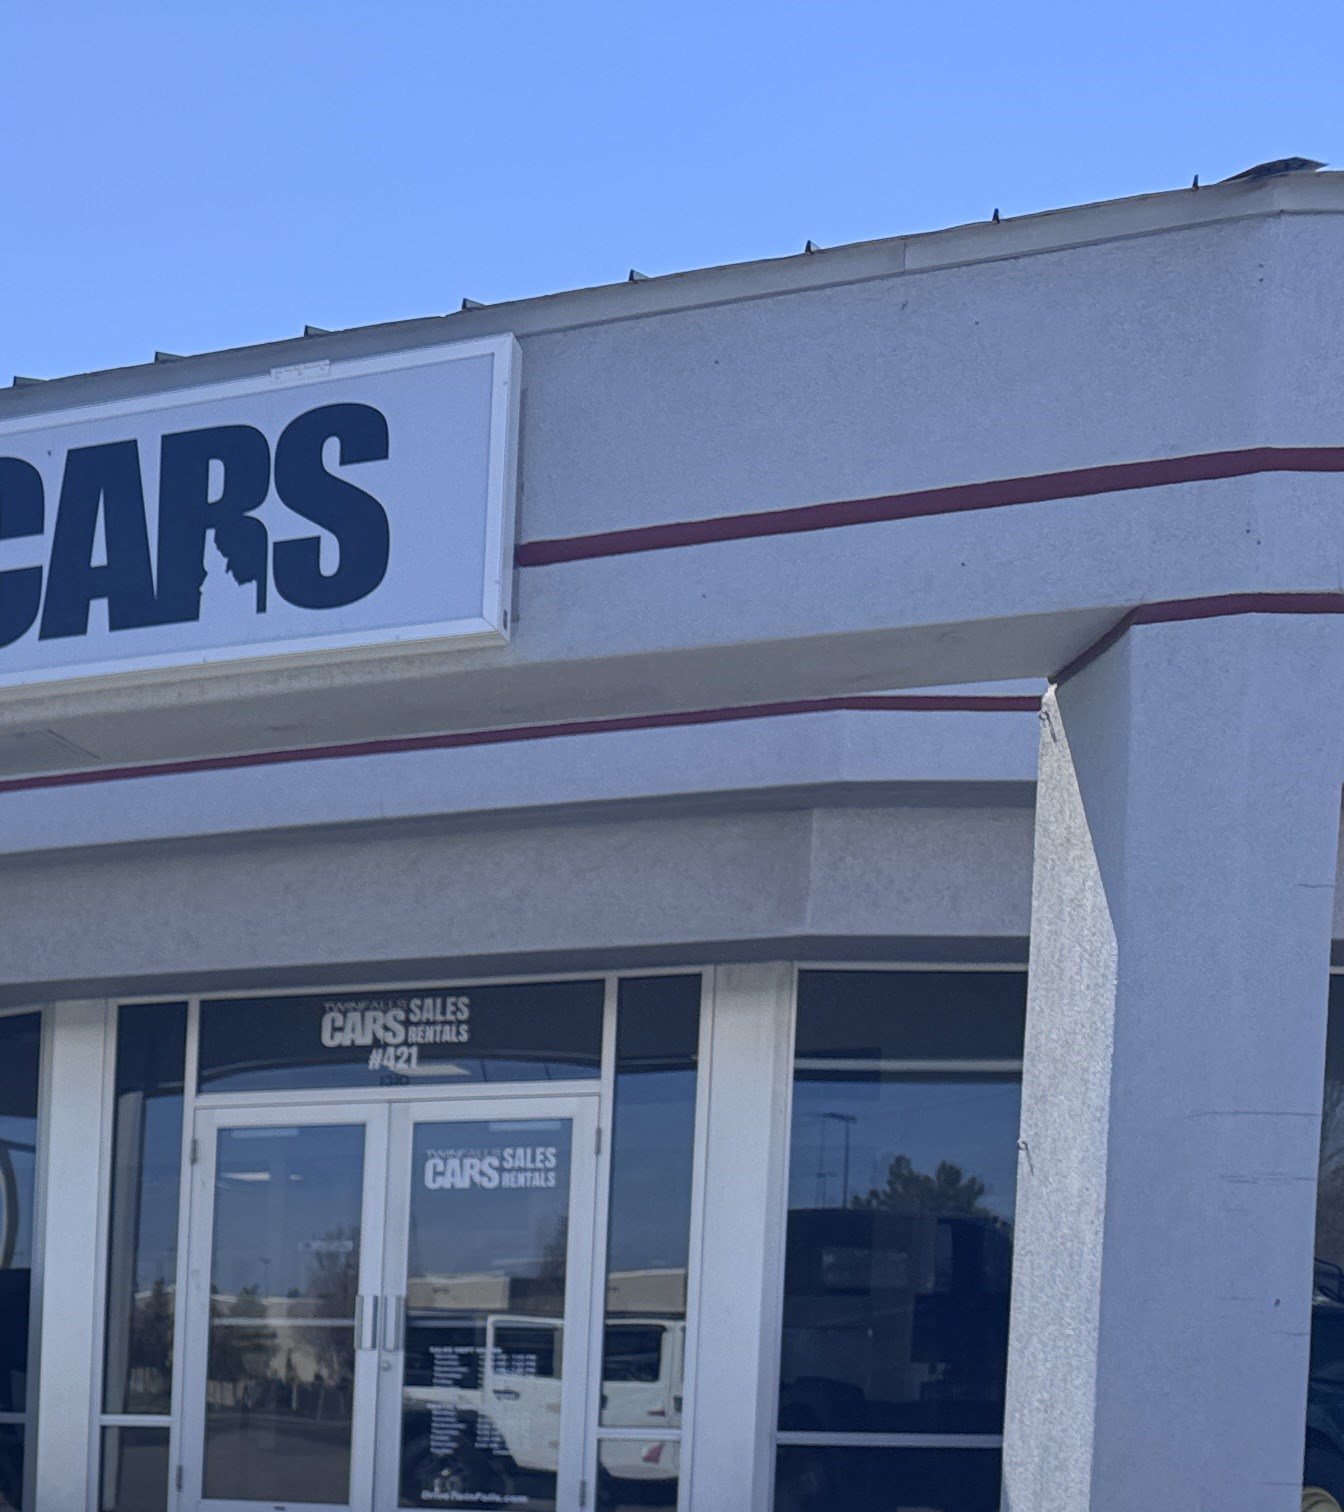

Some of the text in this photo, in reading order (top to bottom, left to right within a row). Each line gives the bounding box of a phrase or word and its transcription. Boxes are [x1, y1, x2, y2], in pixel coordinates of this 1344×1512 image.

[408, 996, 470, 1024] SALES
[321, 1008, 406, 1047] CARS
[407, 1024, 469, 1045] RENTALS
[368, 1045, 418, 1071] #421
[502, 1147, 557, 1169] SALES
[424, 1156, 500, 1190] CARS
[501, 1170, 556, 1189] RENTALS
